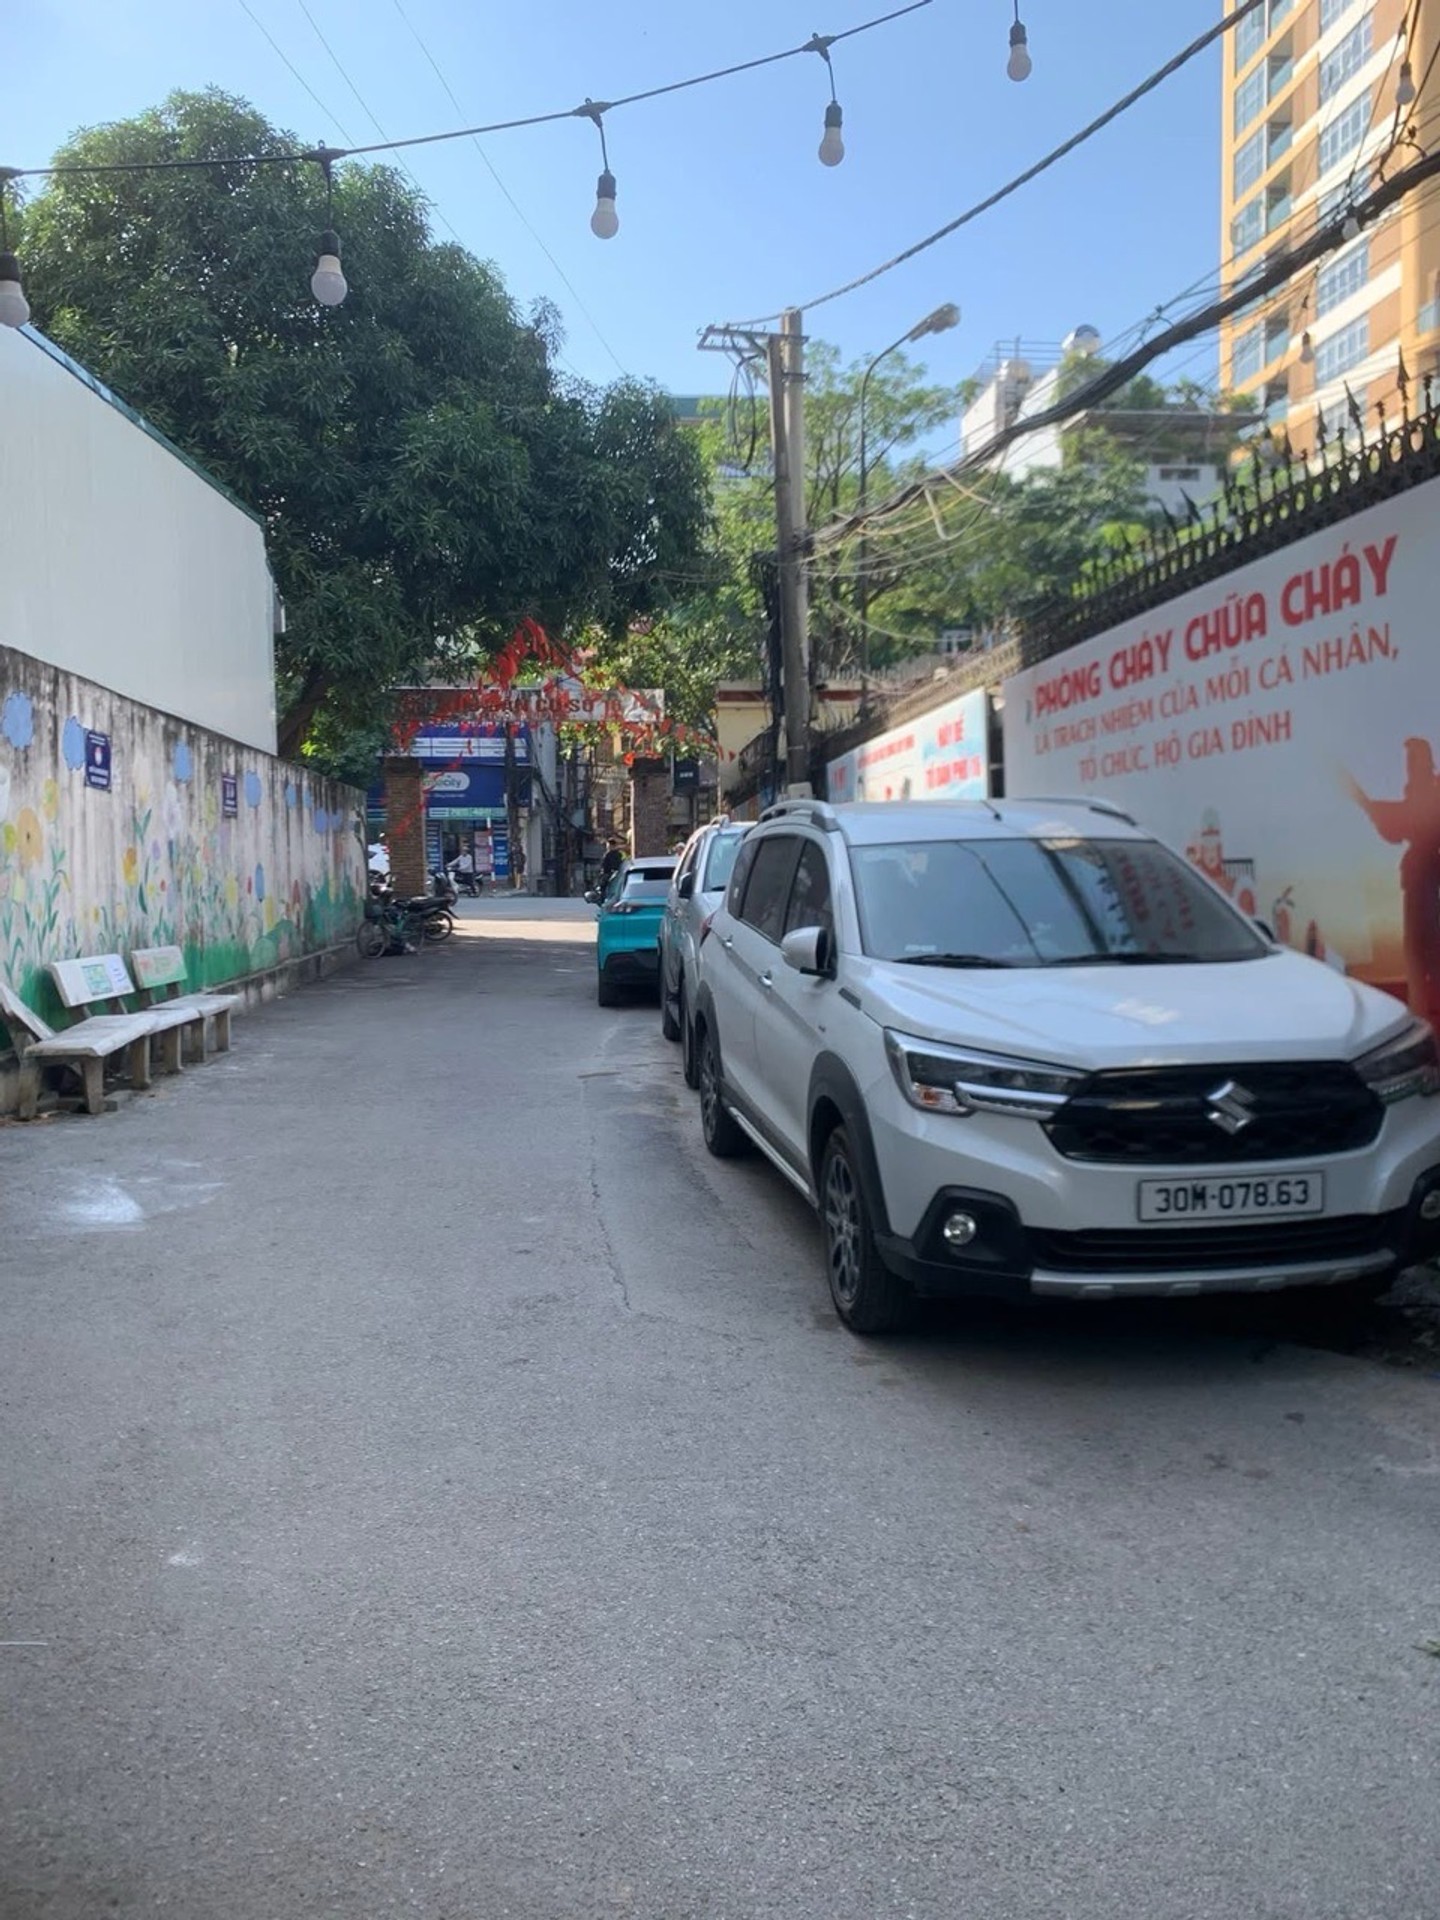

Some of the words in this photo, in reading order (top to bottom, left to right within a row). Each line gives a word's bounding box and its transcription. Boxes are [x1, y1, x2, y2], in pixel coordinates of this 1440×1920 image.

[1036, 661, 1101, 718] PHÒNG
[1109, 629, 1172, 689] CHÁY
[1184, 592, 1267, 661] CHỮA
[1280, 535, 1398, 627] CHÁY
[1101, 698, 1153, 735] NHIỆM
[1160, 680, 1198, 718] CỦA
[1206, 655, 1250, 706] MỖI
[1258, 643, 1294, 690] CÁ
[1303, 622, 1398, 679] NHÂN,
[1154, 730, 1181, 770] HỘ
[1188, 727, 1225, 760] GIA
[1231, 710, 1292, 752] ĐÌNH
